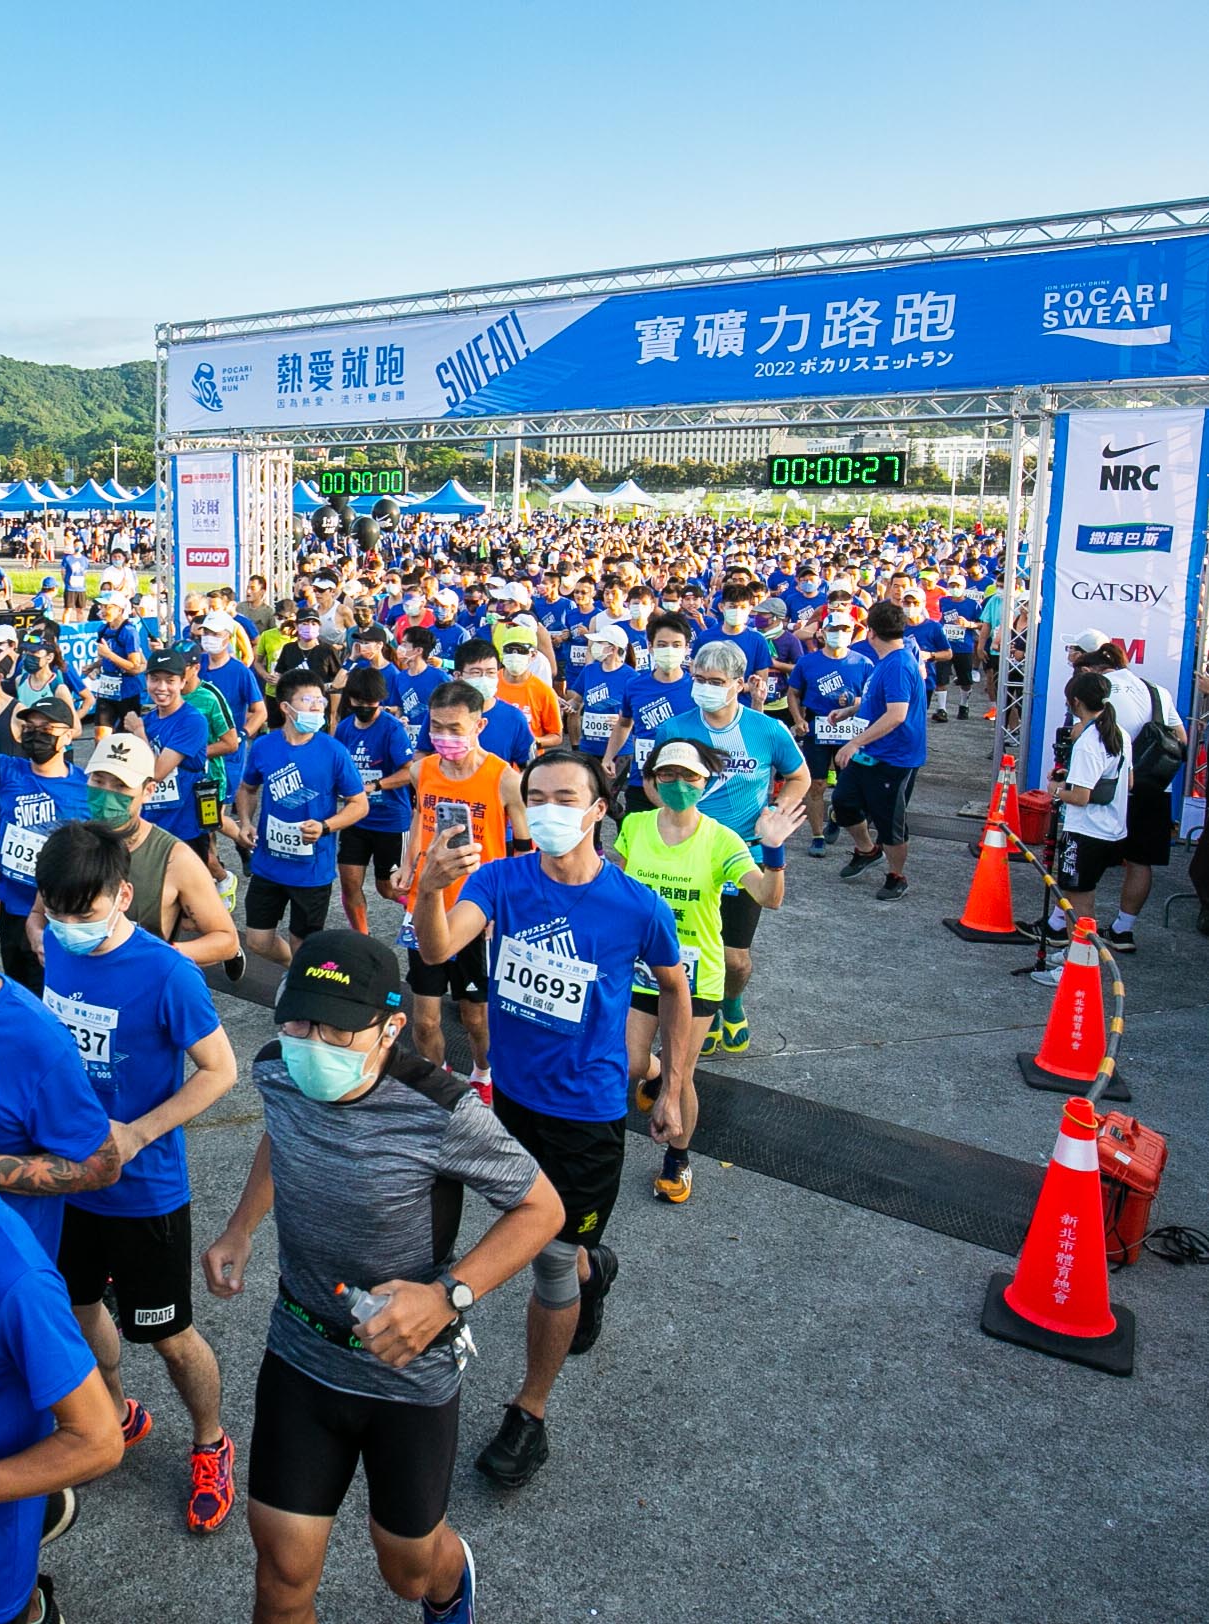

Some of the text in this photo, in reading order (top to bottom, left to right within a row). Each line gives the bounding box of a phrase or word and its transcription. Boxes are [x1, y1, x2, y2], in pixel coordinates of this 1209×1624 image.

[1043, 282, 1168, 310] POCARI
[1042, 303, 1156, 329] SWEAT
[634, 290, 957, 366] 寶礦力路跑
[277, 343, 404, 394] 熱愛就跑
[436, 309, 534, 408] SWEAT!
[754, 350, 955, 377] 2022 ポカリスエットラン
[222, 365, 253, 375] POCARI
[222, 374, 249, 383] SWEAT
[222, 384, 238, 392] RUN
[772, 456, 899, 485] 00:00:27
[1099, 465, 1160, 491] NRC
[192, 499, 219, 515] 波爾
[1089, 531, 1160, 547] 撒隆巴斯
[188, 550, 227, 563] SOYJOY
[1071, 582, 1168, 606] GATSBY
[586, 687, 610, 706] SWEAT!
[818, 675, 845, 696] SWEAT!
[641, 702, 675, 730] SWEAT!
[818, 725, 852, 734] 10588
[269, 770, 303, 802] SWEAT!
[14, 799, 56, 827] SWEAT!
[5, 841, 38, 862] 103
[637, 869, 692, 883] Guide Runner
[305, 967, 350, 985] PUYUMA
[504, 962, 582, 1004] 10693
[500, 1001, 518, 1014] 21K
[1052, 1212, 1079, 1305] 新北市體育總會
[137, 1306, 174, 1324] UPDATE
